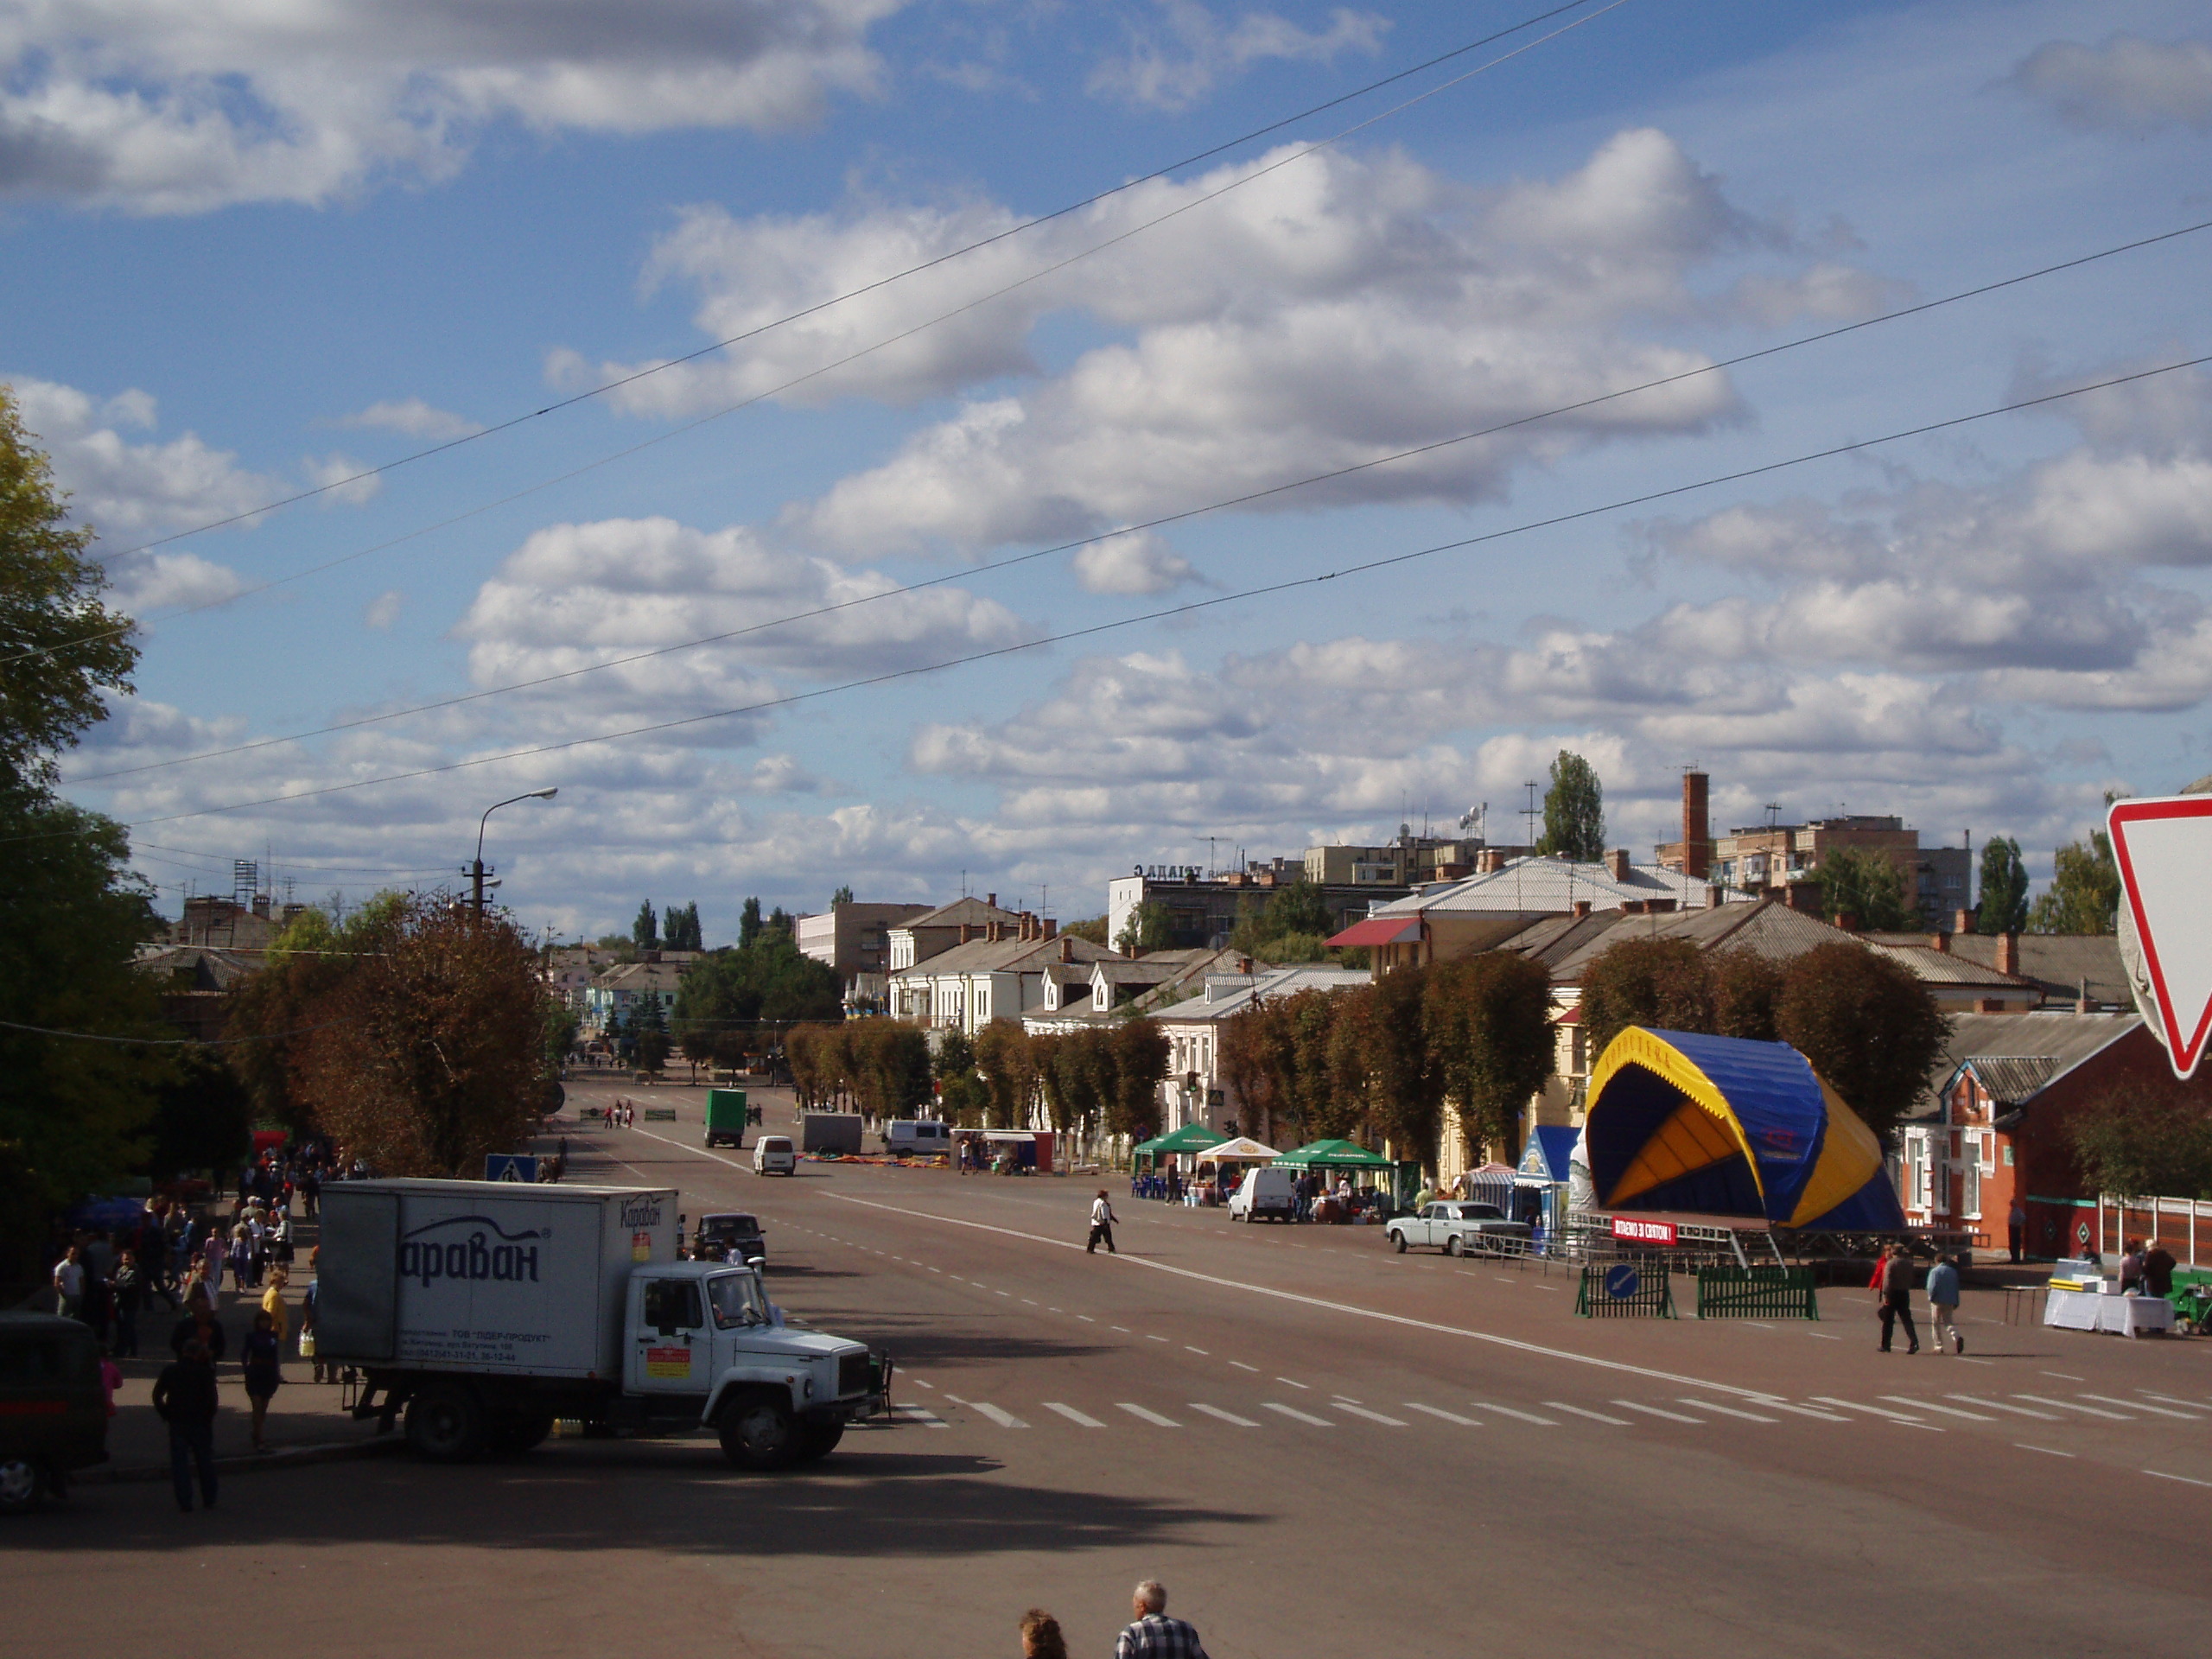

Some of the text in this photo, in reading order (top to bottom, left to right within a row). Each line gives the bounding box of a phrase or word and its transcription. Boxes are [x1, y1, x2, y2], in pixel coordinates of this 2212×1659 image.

[620, 1199, 661, 1233] Караван
[400, 1231, 539, 1287] араван
[452, 1329, 471, 1338] ТОВ
